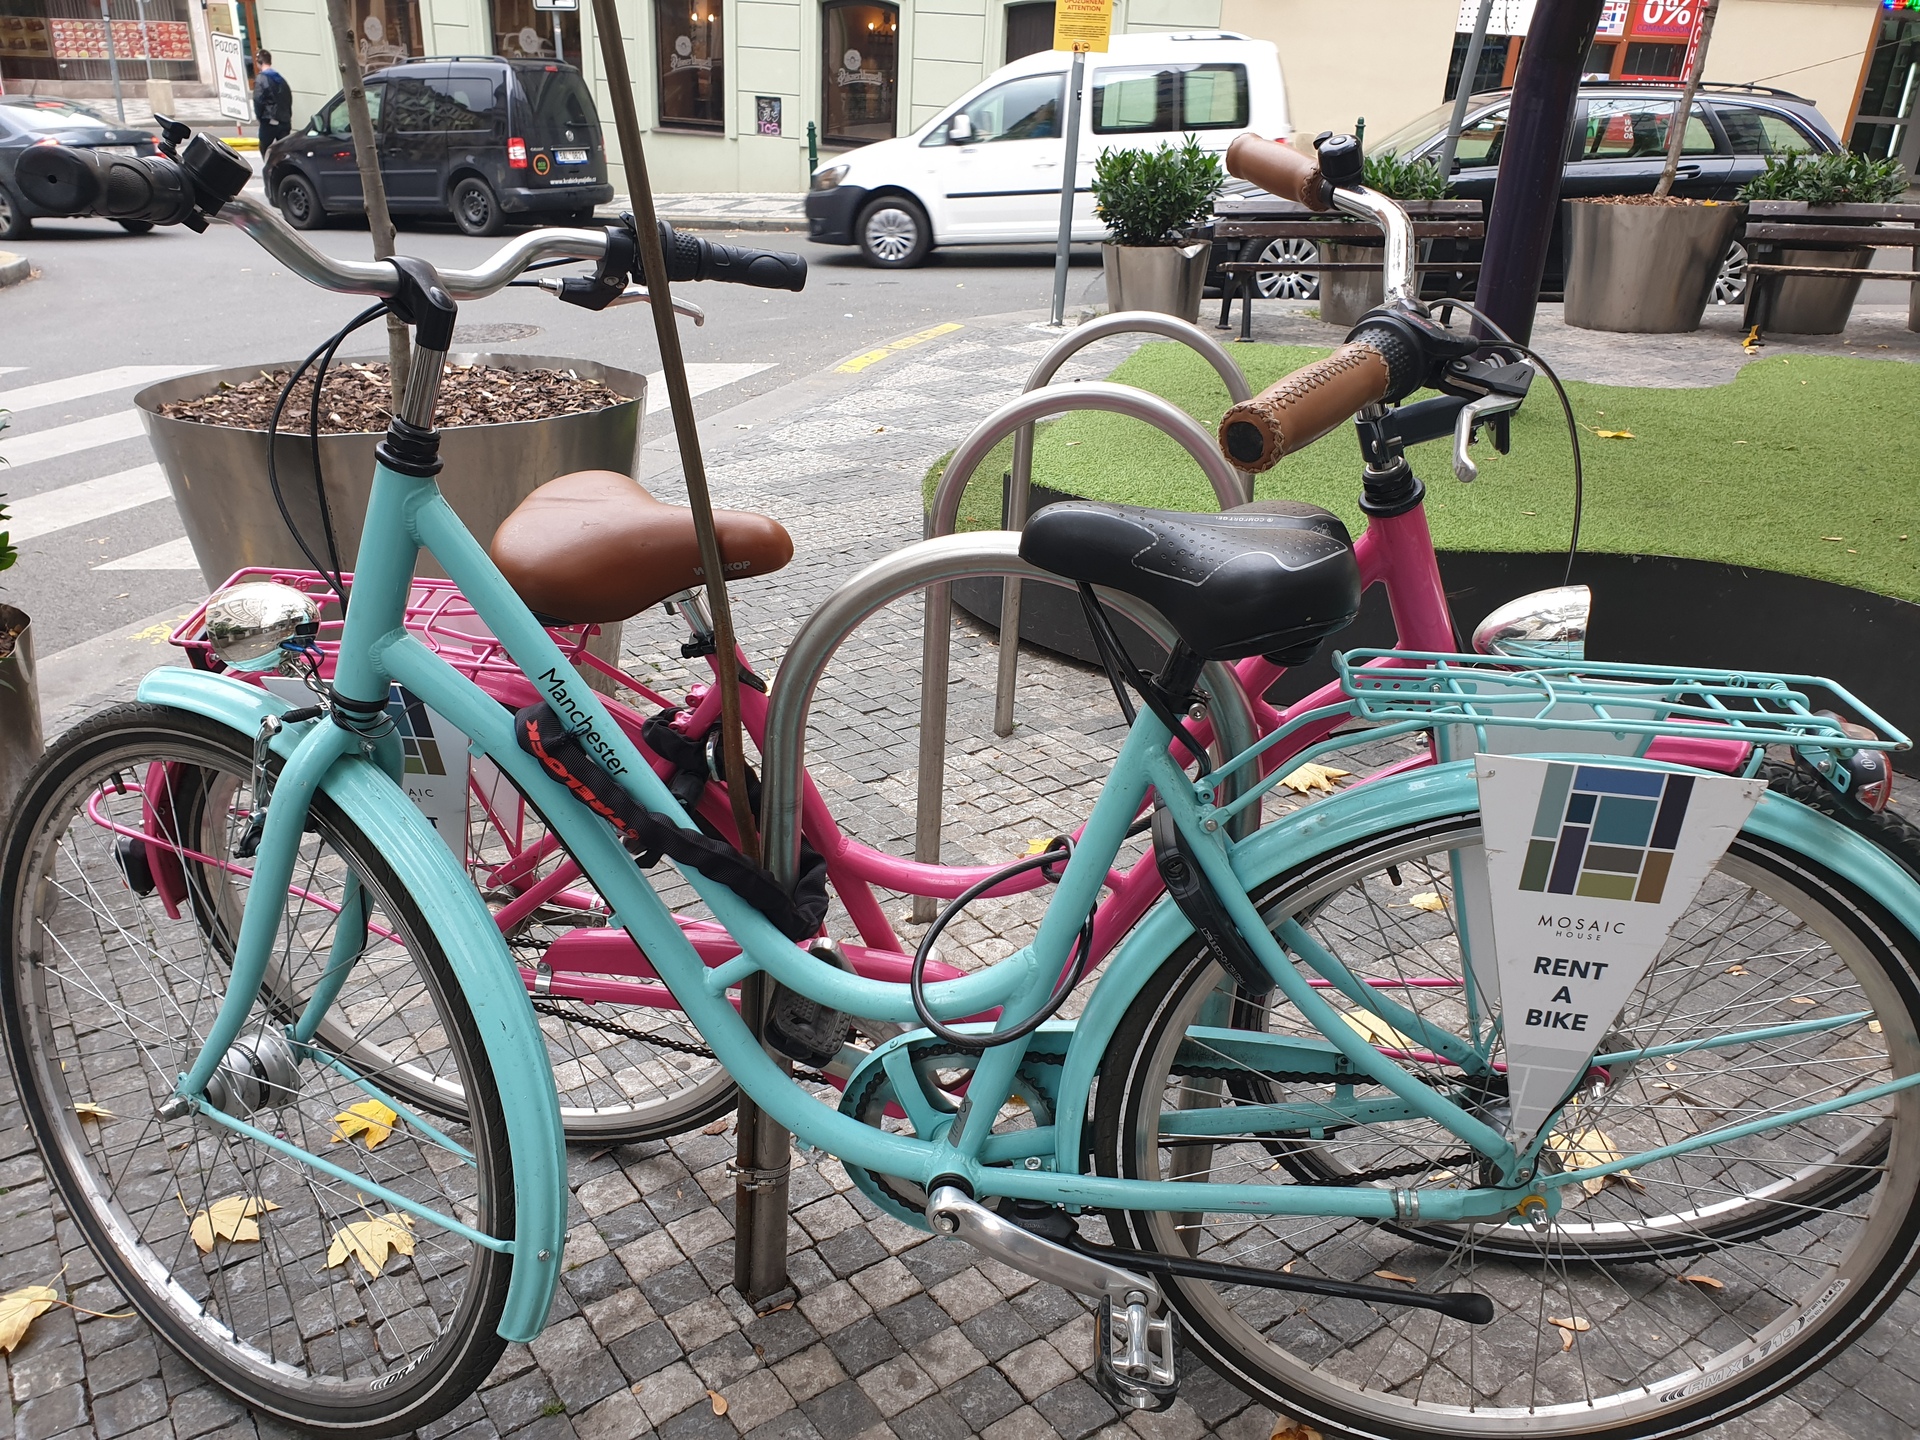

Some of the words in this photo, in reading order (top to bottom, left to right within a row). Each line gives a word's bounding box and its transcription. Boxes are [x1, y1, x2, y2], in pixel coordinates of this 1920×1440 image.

[1643, 0, 1691, 24] 0%
[1636, 24, 1691, 33] COMMISSION
[214, 39, 239, 55] POZOR
[693, 560, 751, 576] WKOP
[538, 667, 628, 777] Manchester
[525, 719, 627, 831] TRELOCK
[1537, 914, 1627, 934] MOSAIC
[1555, 930, 1602, 941] HOUSE
[1533, 956, 1609, 981] RENT
[1551, 986, 1572, 1004] A
[1525, 1009, 1589, 1032] BIKE
